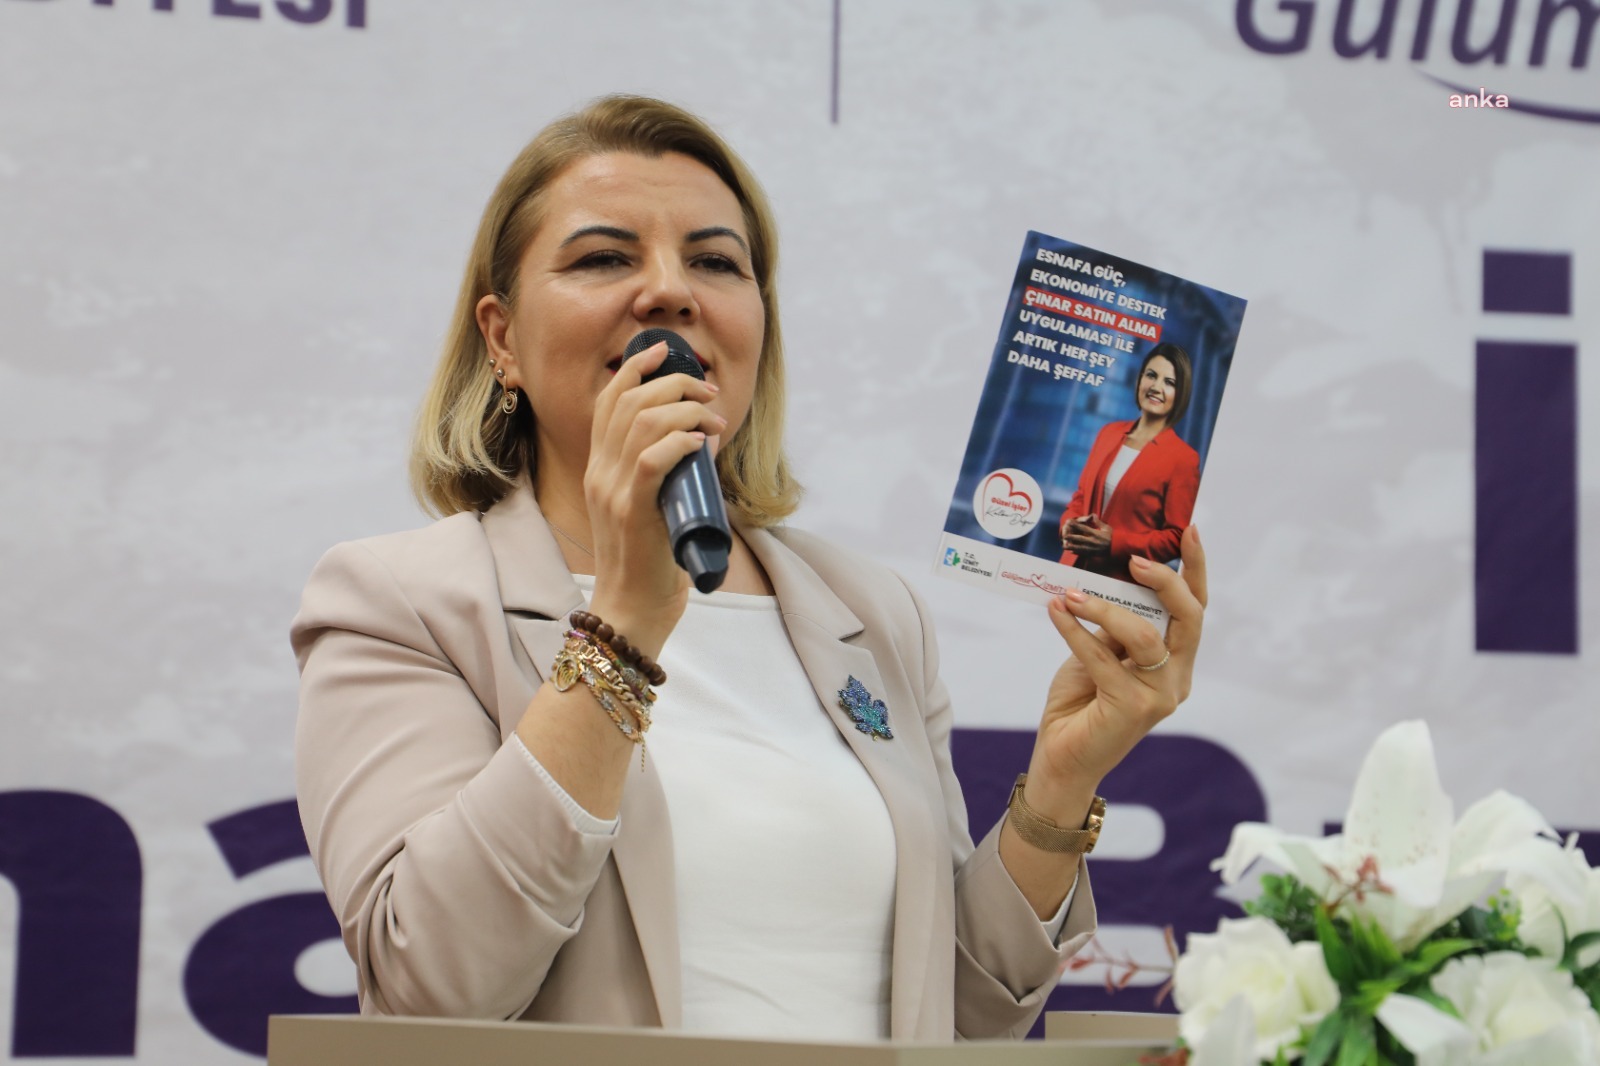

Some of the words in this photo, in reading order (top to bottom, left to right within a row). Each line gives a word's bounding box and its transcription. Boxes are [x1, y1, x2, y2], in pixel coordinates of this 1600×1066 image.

[1035, 247, 1092, 276] ESNAFA
[1093, 264, 1127, 288] GÜÇ,
[1025, 289, 1072, 313] ÇINAR
[1073, 303, 1117, 326] SATIN
[1117, 317, 1157, 339] ALMA
[1030, 268, 1116, 304] EKONOMİYE
[1117, 294, 1168, 320] DESTEK
[1012, 330, 1059, 353] ARTIK
[1059, 343, 1088, 362] HER
[1088, 351, 1116, 369] ŞEY
[1019, 309, 1113, 347] UYGULAMASI
[1114, 334, 1136, 354] İLE
[1006, 350, 1051, 373] DAHA
[1053, 363, 1106, 387] ŞEFFAF
[1105, 594, 1132, 607] KAPLAN
